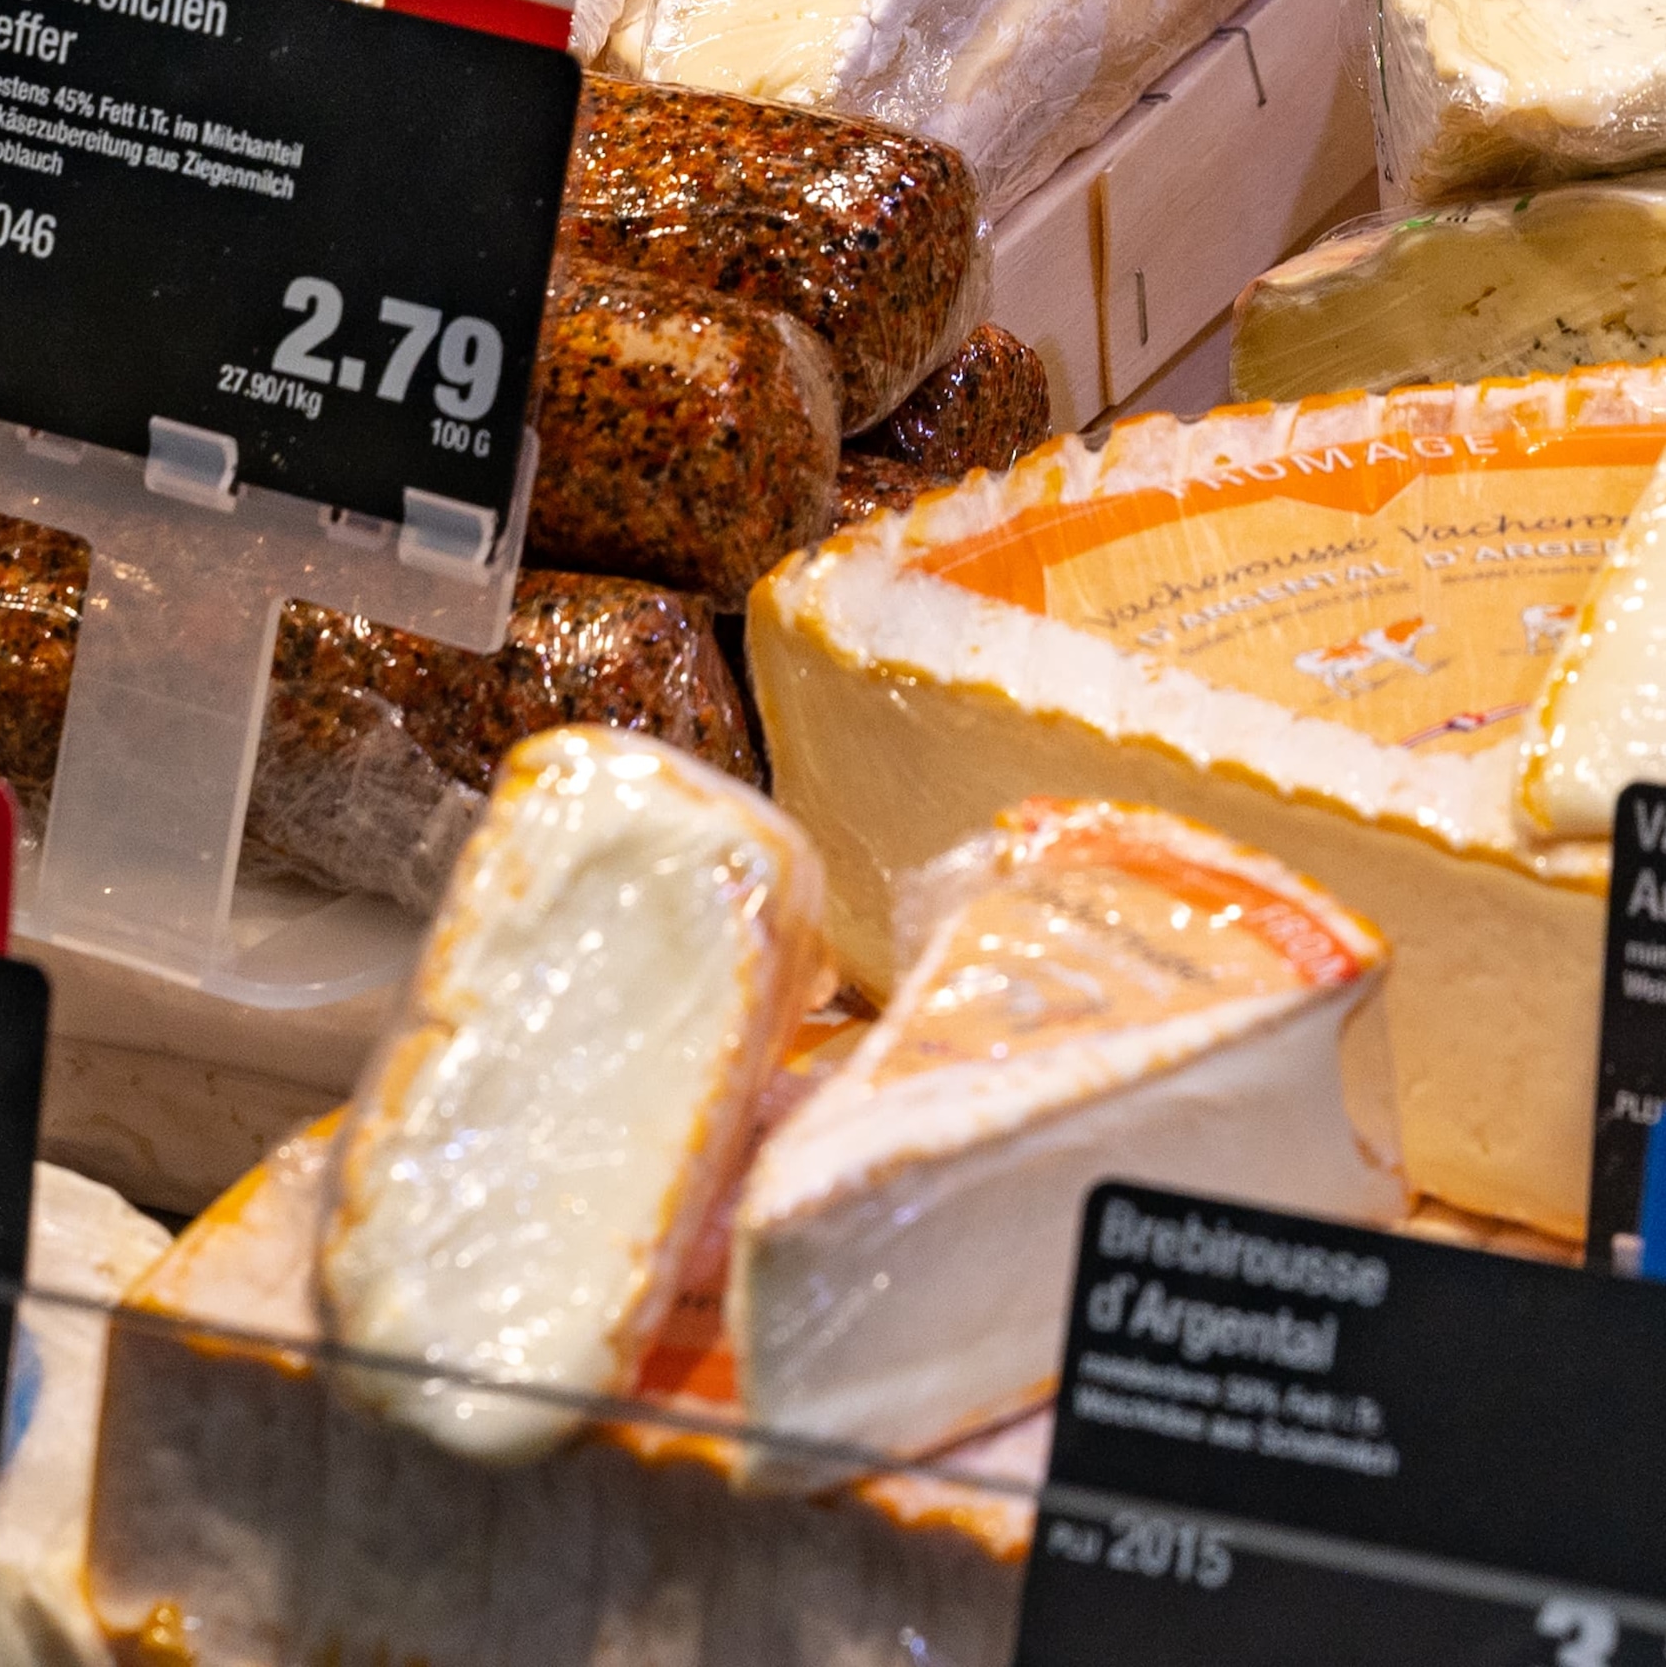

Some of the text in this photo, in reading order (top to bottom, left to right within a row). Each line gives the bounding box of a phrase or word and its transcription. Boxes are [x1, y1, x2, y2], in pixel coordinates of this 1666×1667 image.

[52, 85, 95, 118] 45%
[97, 95, 137, 128] Fett
[136, 105, 170, 137] i.Tr.
[172, 113, 199, 143] im
[200, 120, 304, 168] Milchanteil
[143, 145, 180, 172] aus
[180, 149, 295, 200] Ziegenmilch
[270, 275, 503, 421] 2.79
[217, 363, 323, 420] 27.90/1kg
[430, 411, 491, 458] 100 G
[1107, 1515, 1234, 1589] 2015
